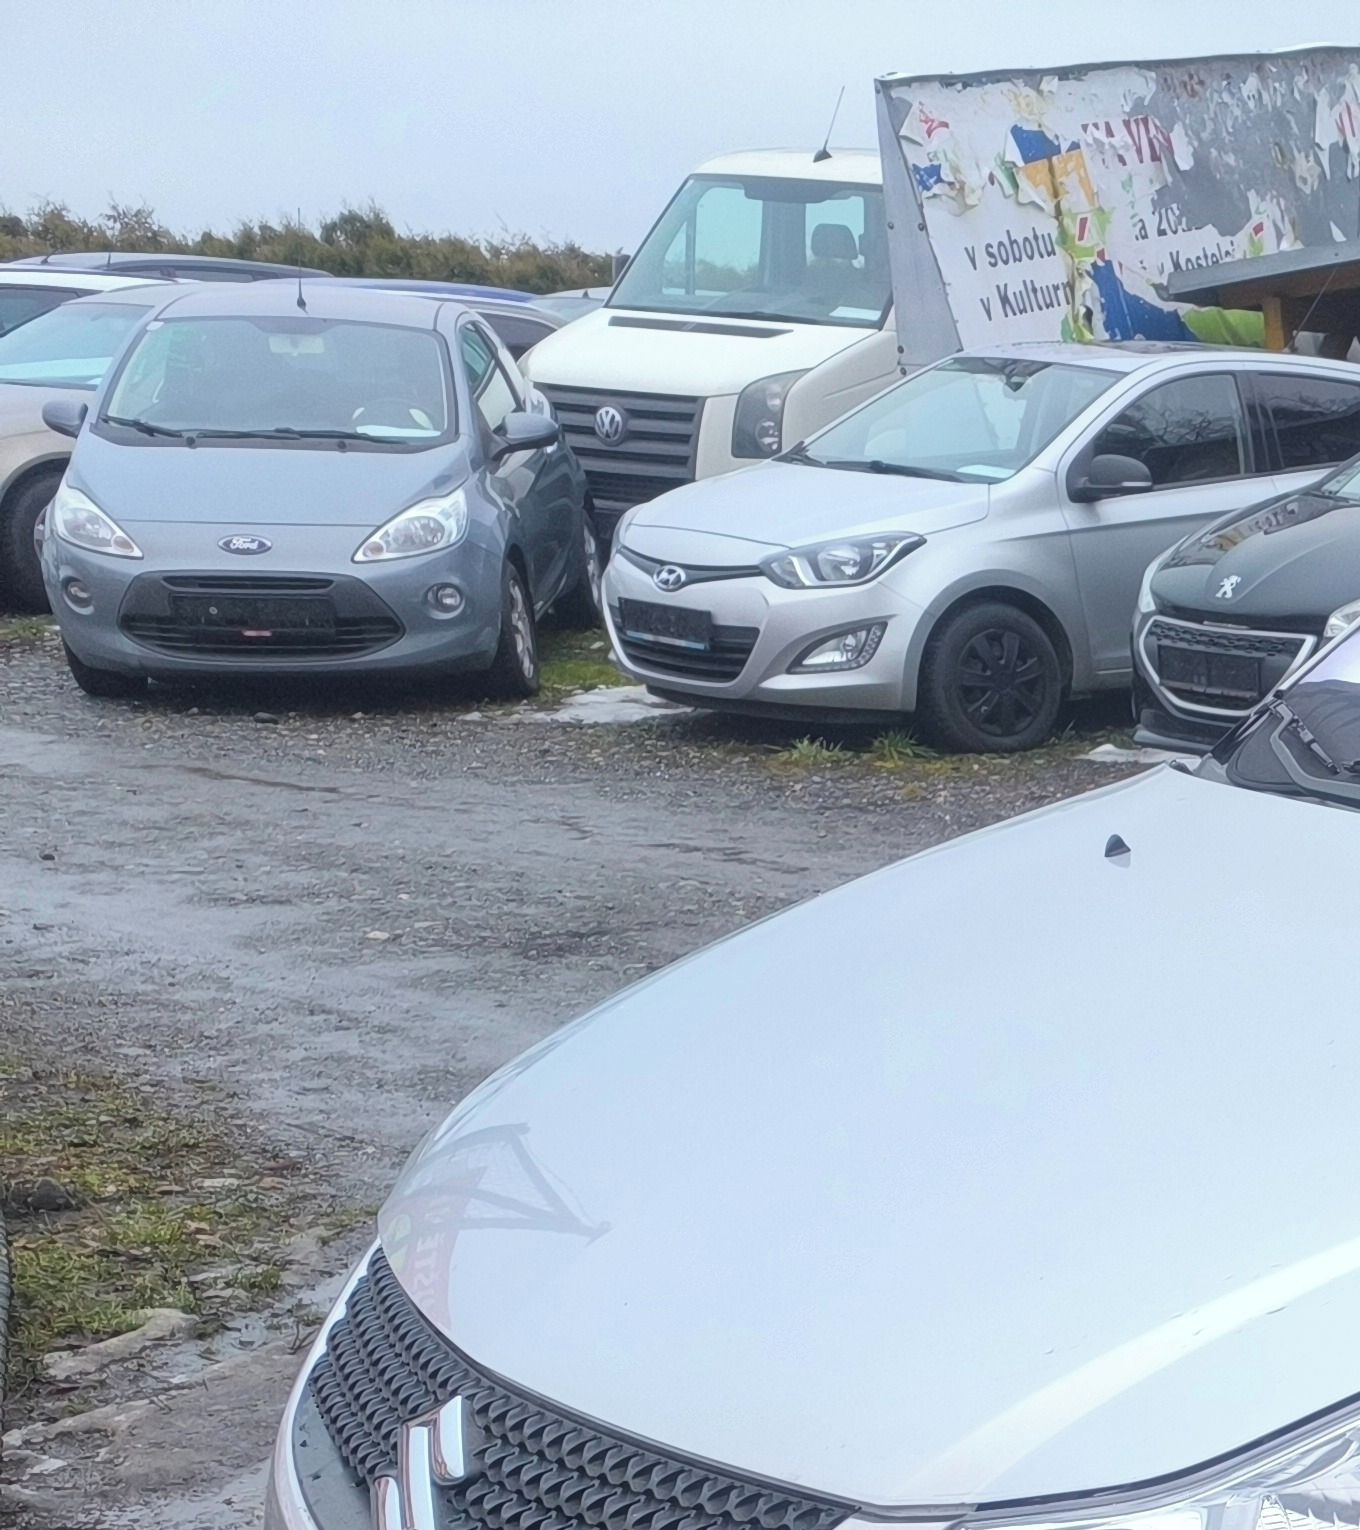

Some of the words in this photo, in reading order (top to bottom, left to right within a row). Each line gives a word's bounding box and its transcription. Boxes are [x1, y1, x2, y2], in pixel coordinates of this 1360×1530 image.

[964, 245, 977, 271] v
[985, 226, 1057, 268] sobotu
[979, 296, 992, 322] v
